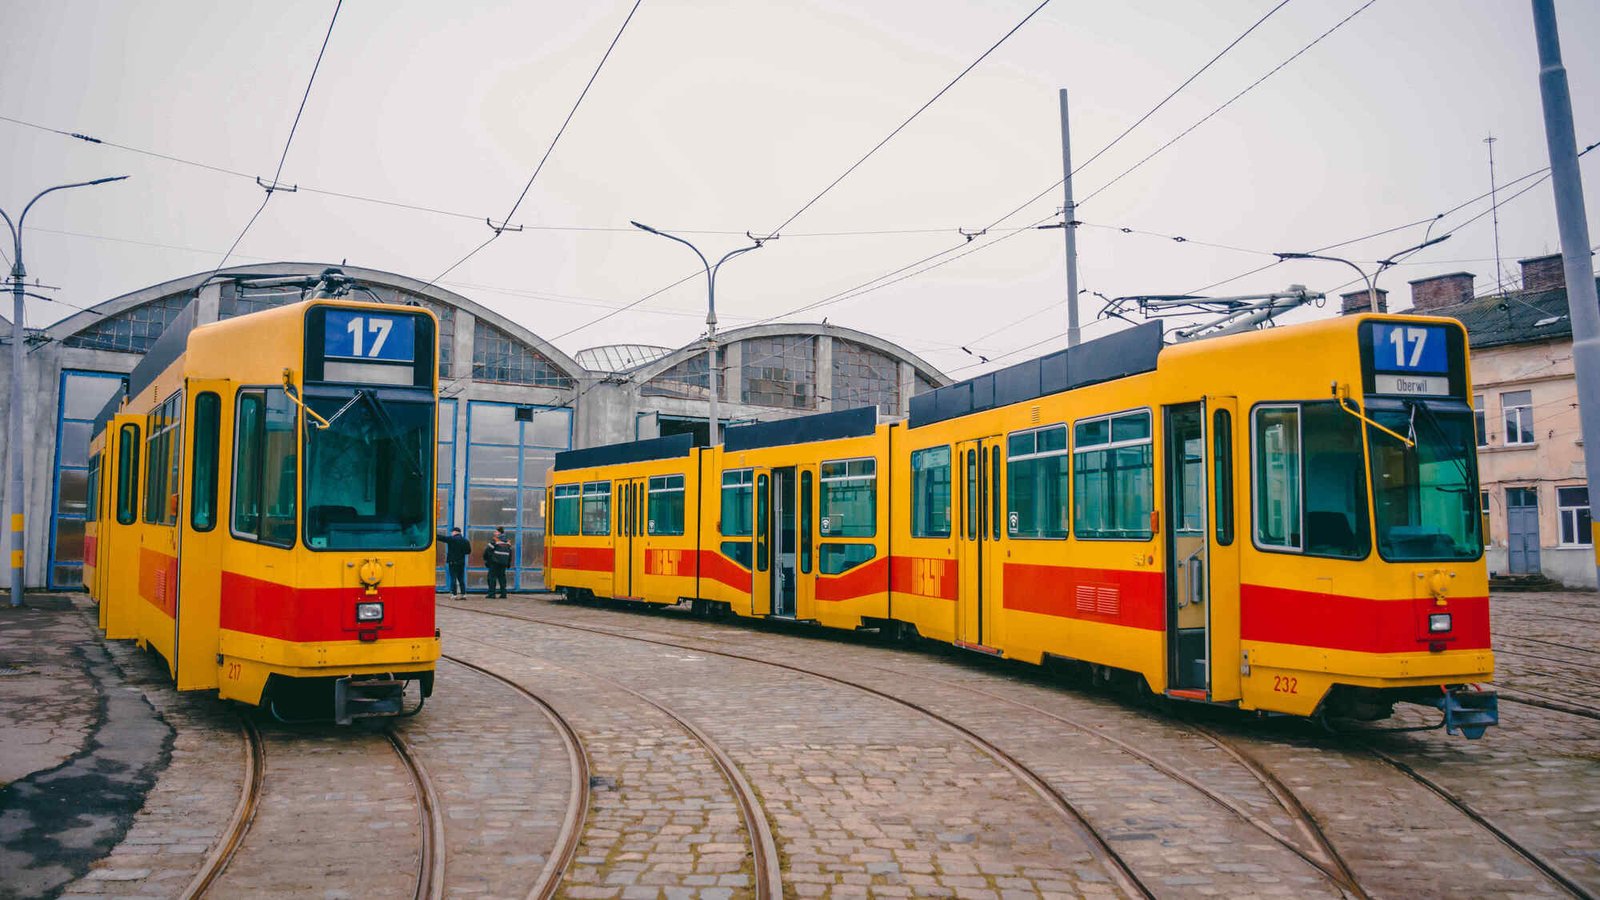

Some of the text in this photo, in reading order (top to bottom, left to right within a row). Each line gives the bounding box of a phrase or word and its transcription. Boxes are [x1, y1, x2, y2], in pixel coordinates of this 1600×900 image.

[347, 317, 393, 357] 17
[1390, 327, 1428, 367] 17
[1396, 378, 1428, 392] Oberwil
[229, 662, 242, 681] 217
[1273, 675, 1298, 694] 232
